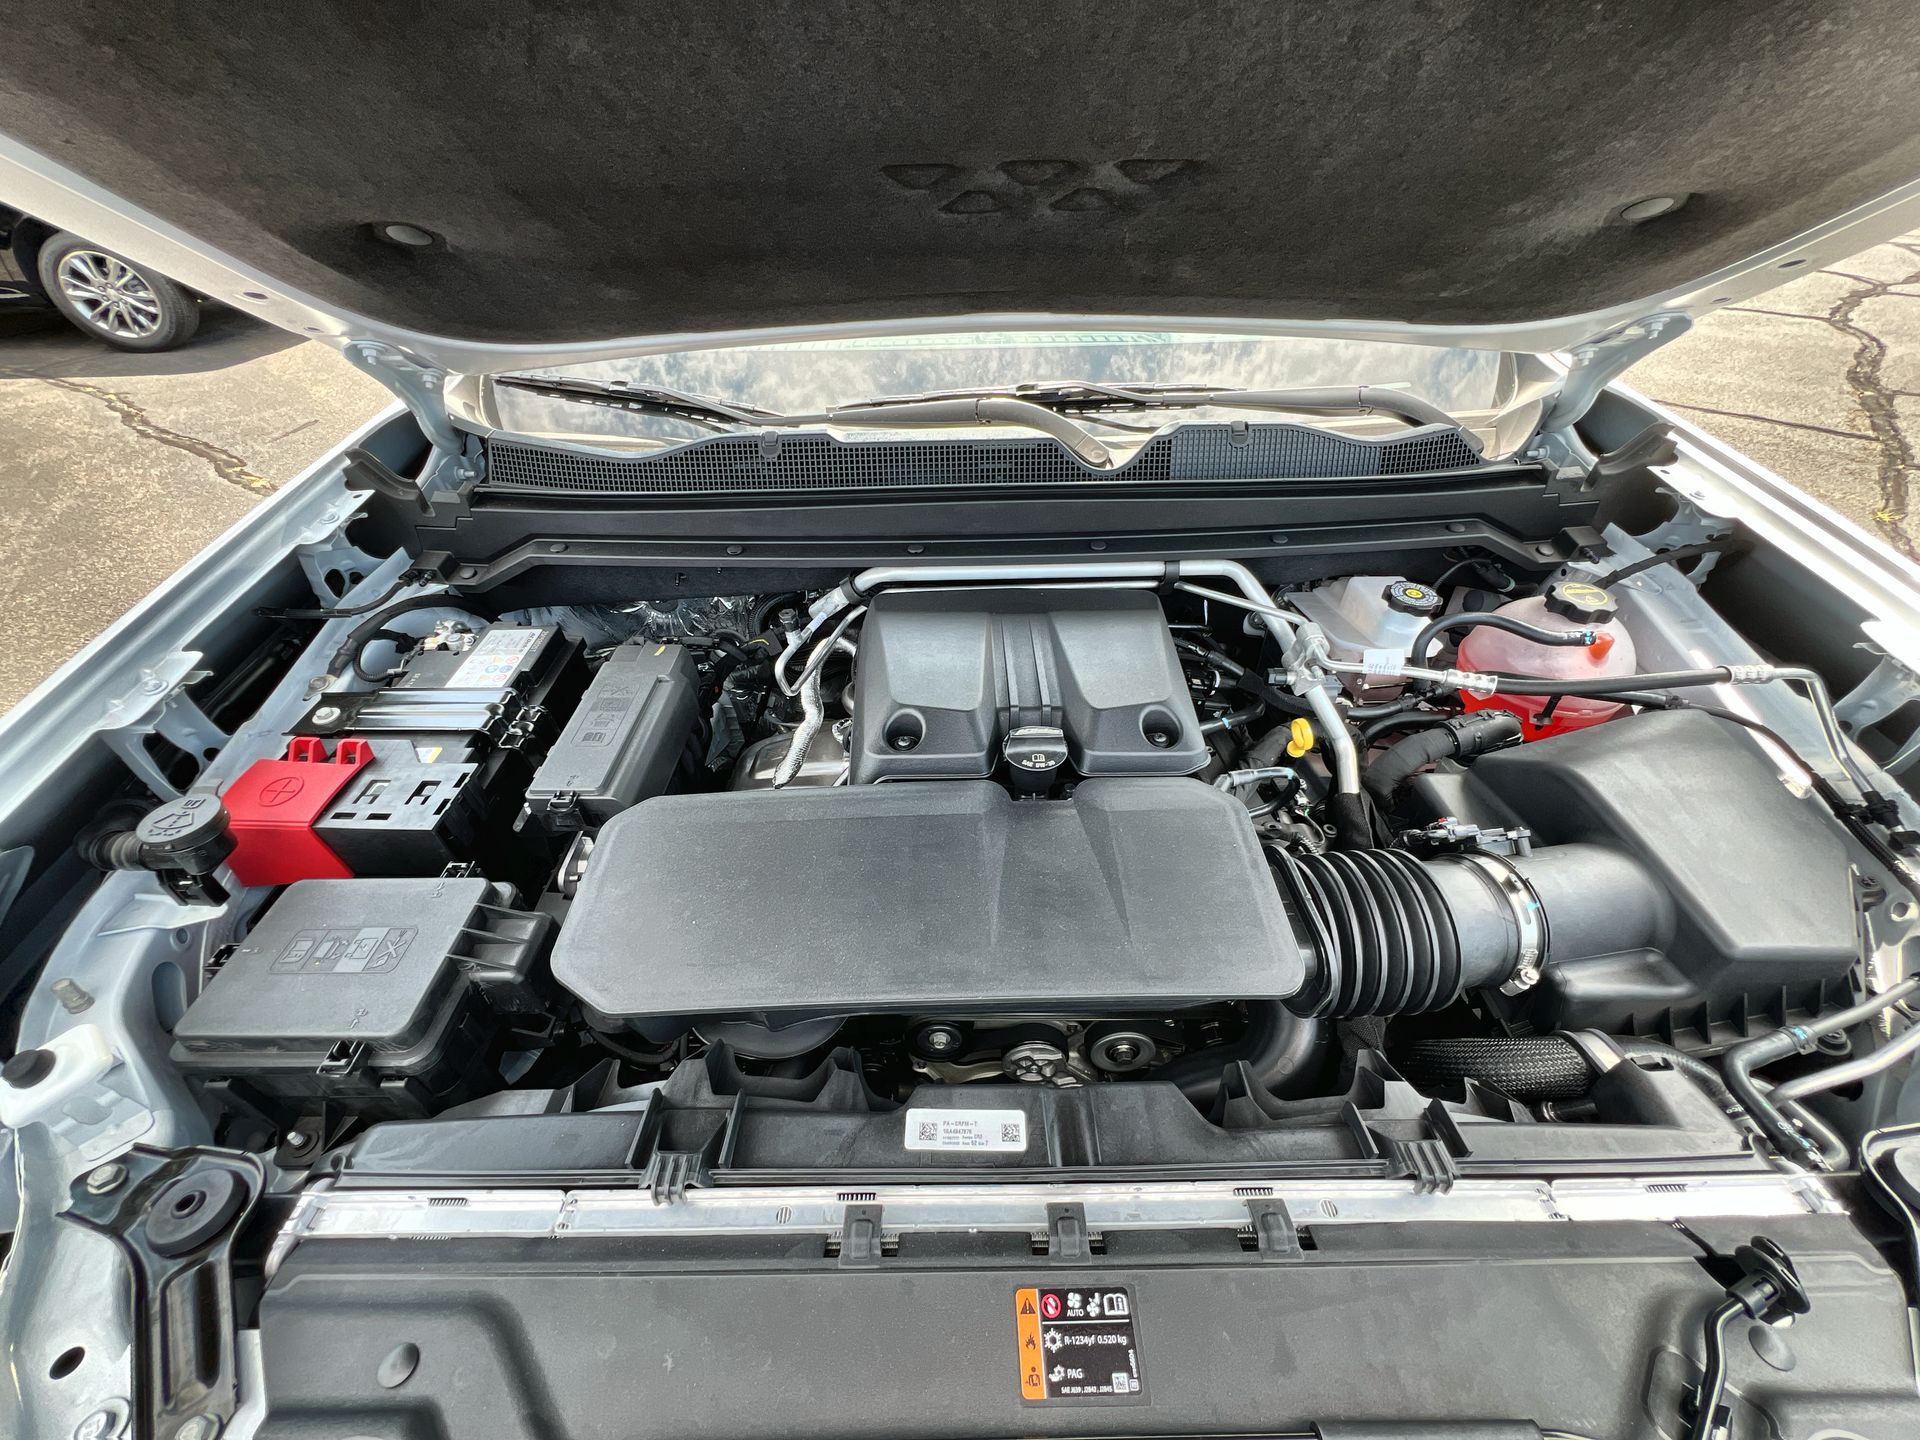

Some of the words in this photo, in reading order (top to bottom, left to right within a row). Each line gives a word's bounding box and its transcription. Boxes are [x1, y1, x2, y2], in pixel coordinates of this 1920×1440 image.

[1067, 1309, 1084, 1317] AUTO
[1064, 1335, 1095, 1346] R-1234yf
[1097, 1335, 1117, 1344] 0.520
[1117, 1334, 1127, 1346] kg
[1067, 1368, 1083, 1379] PAG
